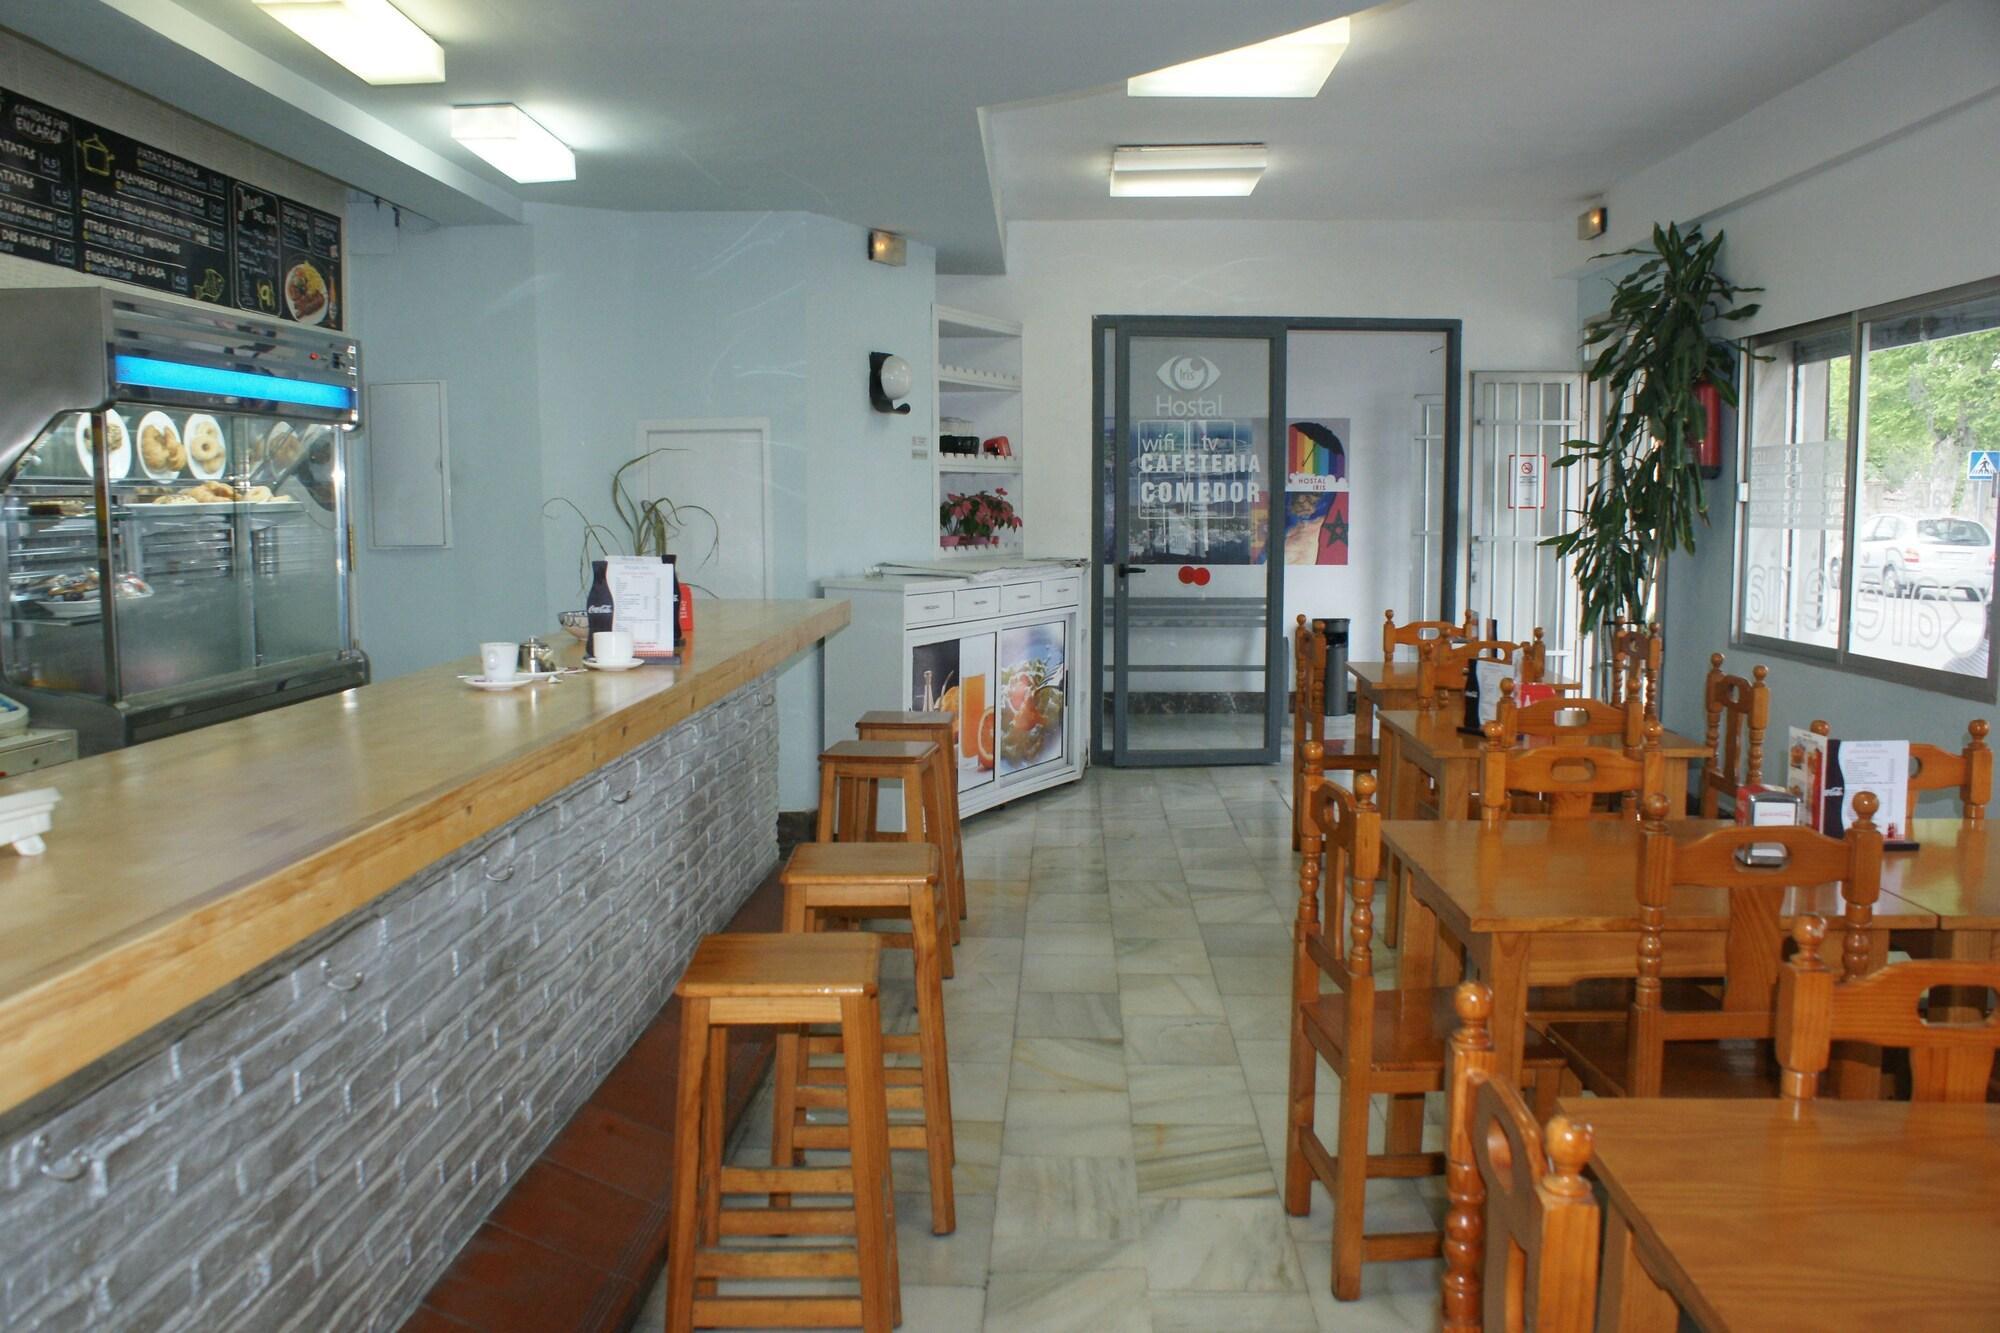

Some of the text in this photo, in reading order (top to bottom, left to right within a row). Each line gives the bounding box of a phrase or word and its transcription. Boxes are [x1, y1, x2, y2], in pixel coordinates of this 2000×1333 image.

[0, 138, 35, 161] ATATAS
[0, 168, 34, 189] ATATAS
[1180, 367, 1194, 381] Iris
[1156, 395, 1222, 417] Hostal
[1142, 432, 1219, 452] wifi tv
[1140, 454, 1260, 473] CAFETERIA
[1141, 482, 1260, 503] COMEDOR
